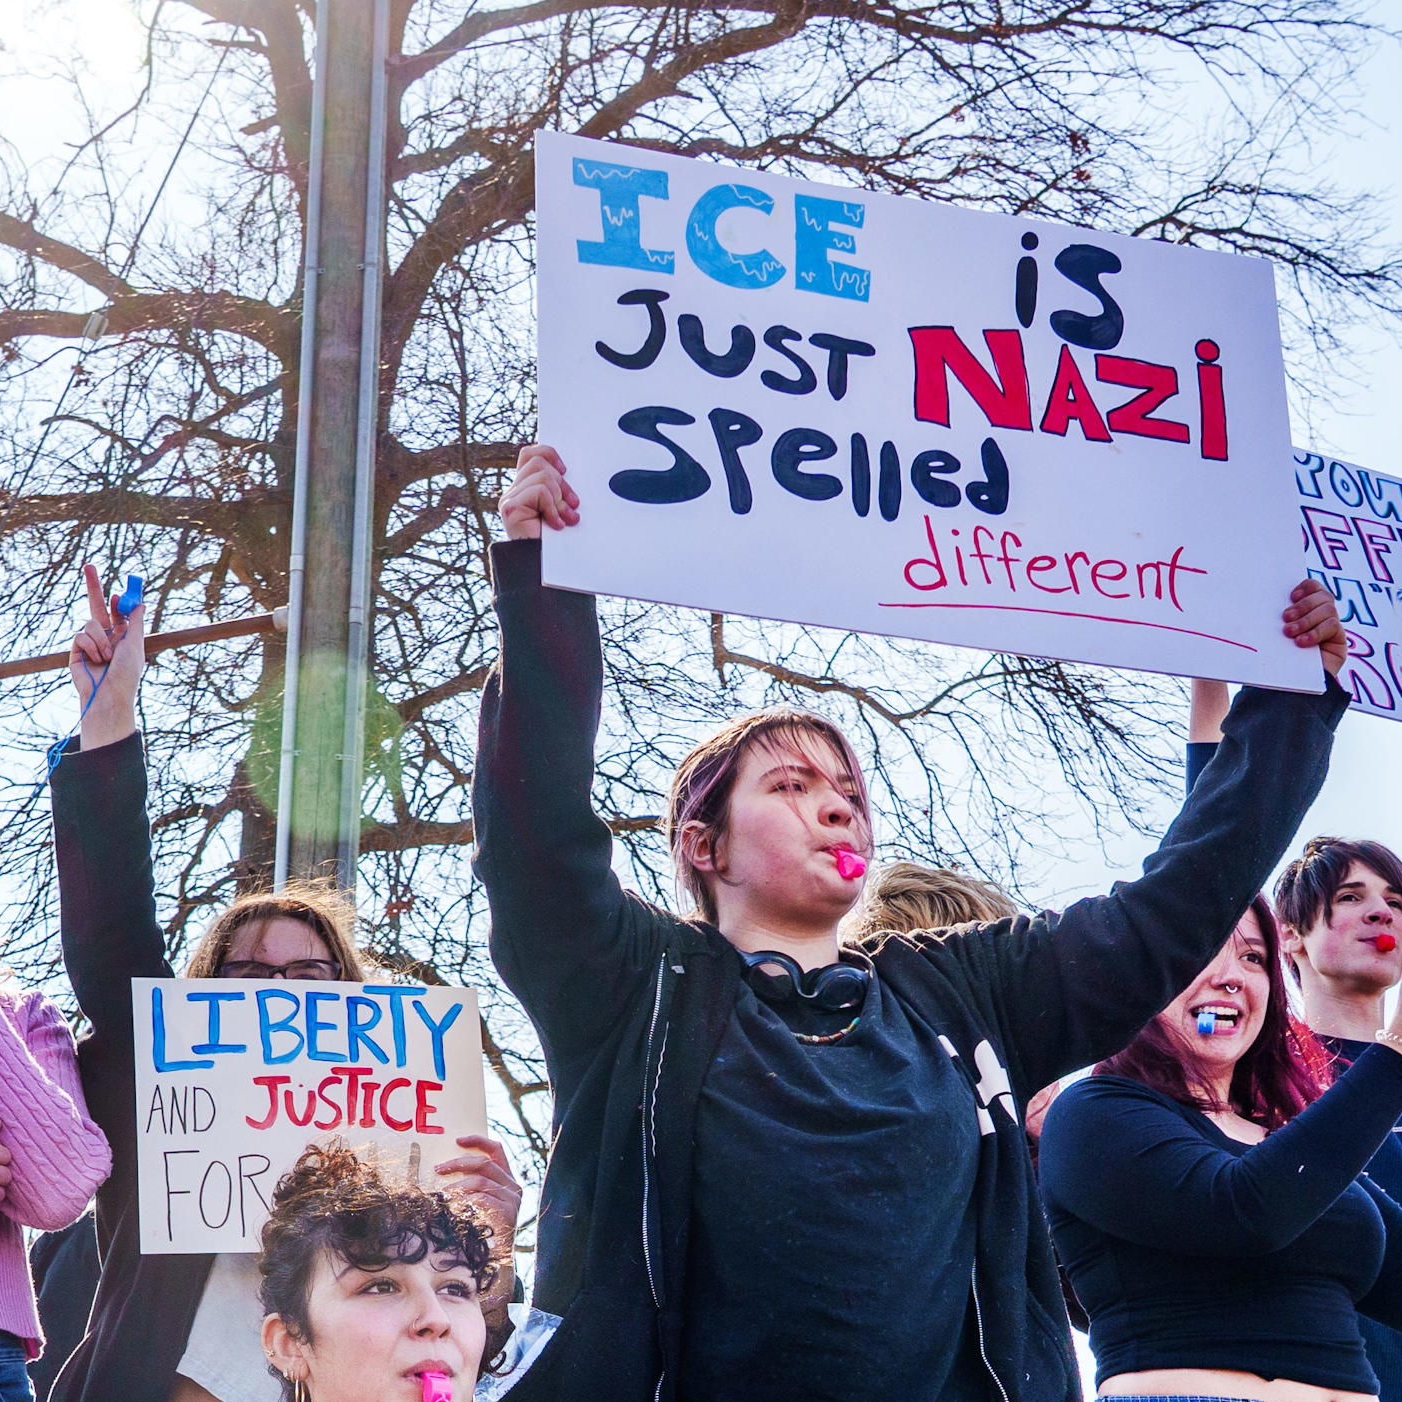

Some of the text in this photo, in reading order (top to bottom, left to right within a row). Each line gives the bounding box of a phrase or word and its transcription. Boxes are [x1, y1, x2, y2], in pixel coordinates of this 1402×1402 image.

[572, 158, 871, 303] ICE
[596, 289, 875, 400] JUST
[904, 516, 1207, 611] different
[152, 986, 463, 1081] LIBERTY
[146, 1067, 445, 1135] AND JUSTICE
[164, 1150, 272, 1241] FOR
